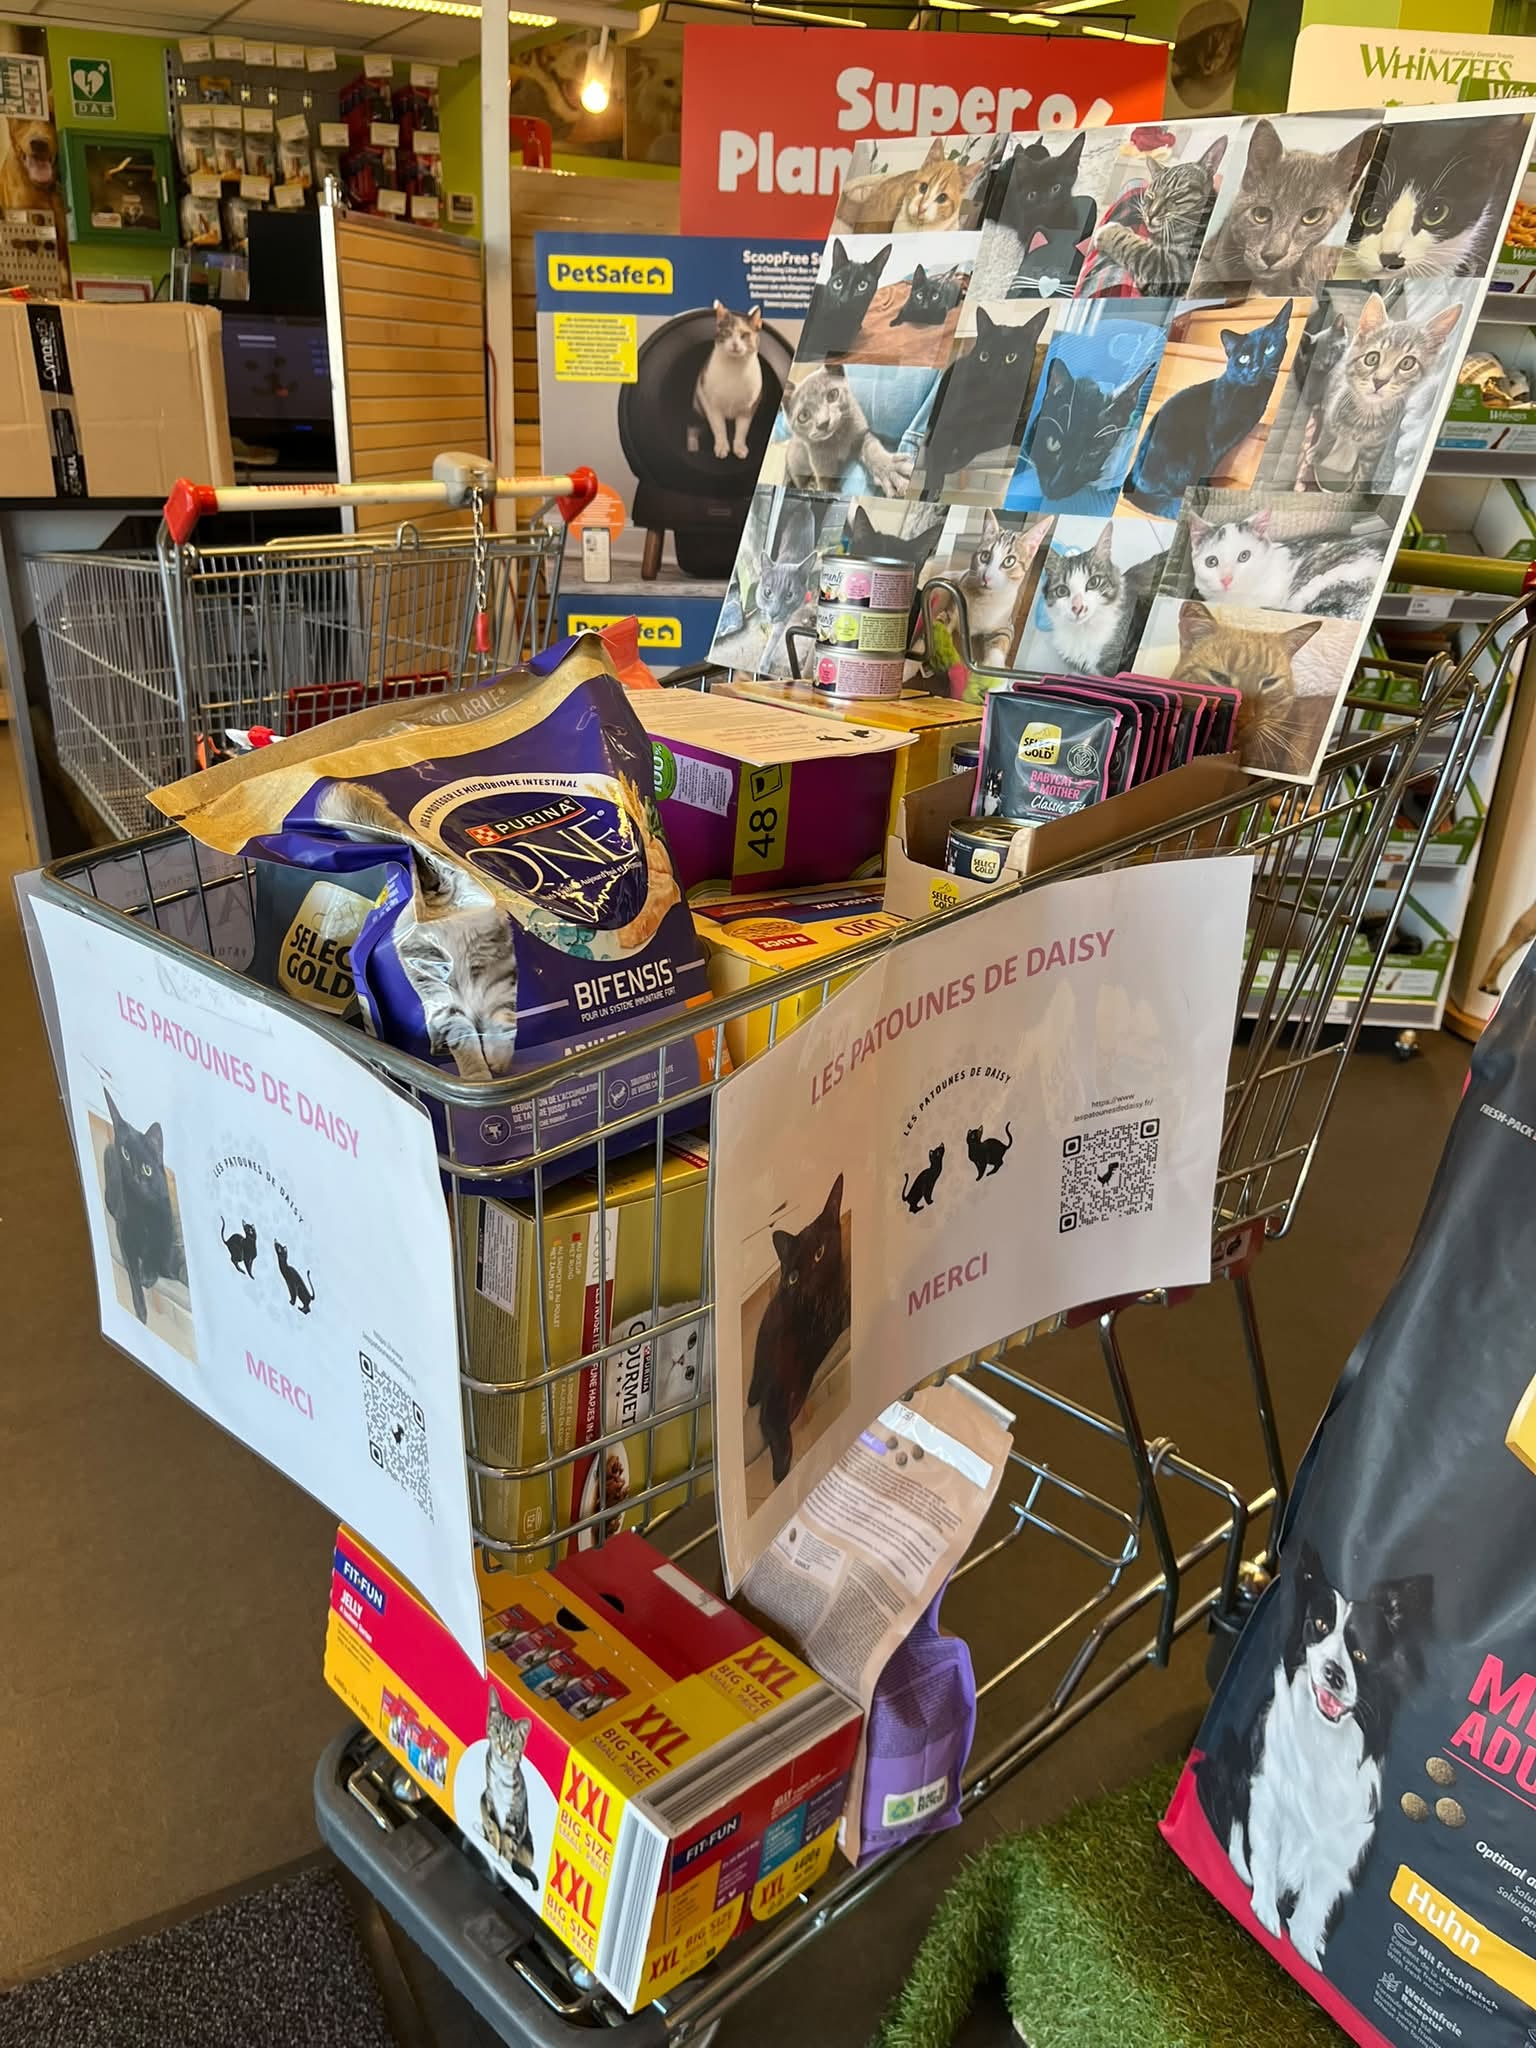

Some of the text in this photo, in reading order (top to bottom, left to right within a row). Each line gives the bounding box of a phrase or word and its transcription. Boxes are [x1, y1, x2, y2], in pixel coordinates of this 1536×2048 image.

[78, 104, 112, 115] DAE
[836, 66, 1032, 137] Super
[557, 263, 644, 285] PetSafe
[743, 250, 809, 267] ScoopFree
[463, 779, 522, 795] MICROBIOME
[522, 778, 578, 788] INTESTINAL
[1031, 795, 1065, 814] Classic
[1040, 783, 1080, 800] MOTHER
[495, 802, 576, 834] PURINA
[747, 807, 779, 859] 48
[465, 813, 640, 894] ONE
[973, 858, 997, 869] SELECT
[974, 865, 994, 875] GOLD
[931, 890, 957, 905] SELECT
[290, 923, 353, 973] SELEC
[758, 934, 809, 949] SAUCE
[832, 918, 885, 938] DUO
[286, 953, 353, 998] GOLD
[573, 958, 674, 1010] BIFENSIS
[581, 1010, 599, 1023] POUR
[599, 1007, 609, 1017] UN
[634, 990, 664, 1007] IMMUNITAIRE
[664, 986, 676, 997] FORT
[811, 928, 1116, 1104] LES PATOUNES DE DAISY
[117, 991, 360, 1159] LES PATOUNES DE DAISY
[903, 1066, 1011, 1137] LES PATOUNES DE DAISY
[213, 1162, 224, 1178] LES
[224, 1156, 262, 1175] PATOUNES
[280, 1186, 304, 1223] DAISY
[907, 1251, 989, 1317] MERCI
[245, 1350, 315, 1421] MERCI
[641, 1357, 652, 1392] PURINA
[587, 1389, 597, 1421] HAPJES
[340, 1589, 364, 1620] JELLY
[716, 1664, 773, 1709] BIG SIZE
[732, 1644, 800, 1699] XXL
[601, 1727, 661, 1779] BIG SIZE
[620, 1703, 692, 1768] XXL
[591, 1736, 647, 1787] SMALL PRICE
[565, 1761, 613, 1844] XXL
[560, 1808, 611, 1866] BIG SIZE
[1475, 1840, 1528, 1881] Optimal
[550, 1847, 597, 1932] XXL
[759, 1872, 784, 1907] XXL
[546, 1893, 596, 1950] BIG SIZE
[685, 1908, 733, 1949] BIG SIZE
[1406, 1881, 1482, 1957] Huhn
[649, 1945, 680, 1984] XXL
[1391, 1935, 1420, 1963] Contient
[1420, 1959, 1430, 1971] de
[1402, 1952, 1422, 1974] carne
[1422, 1967, 1445, 1993] fresca
[1404, 1963, 1422, 1983] fresh
[1422, 1980, 1443, 1998] meat
[1417, 1944, 1499, 2010] Mit Frischfleisch
[1400, 1993, 1444, 2033] Rezeptur
[1404, 1984, 1463, 2038] Weizenfreie
